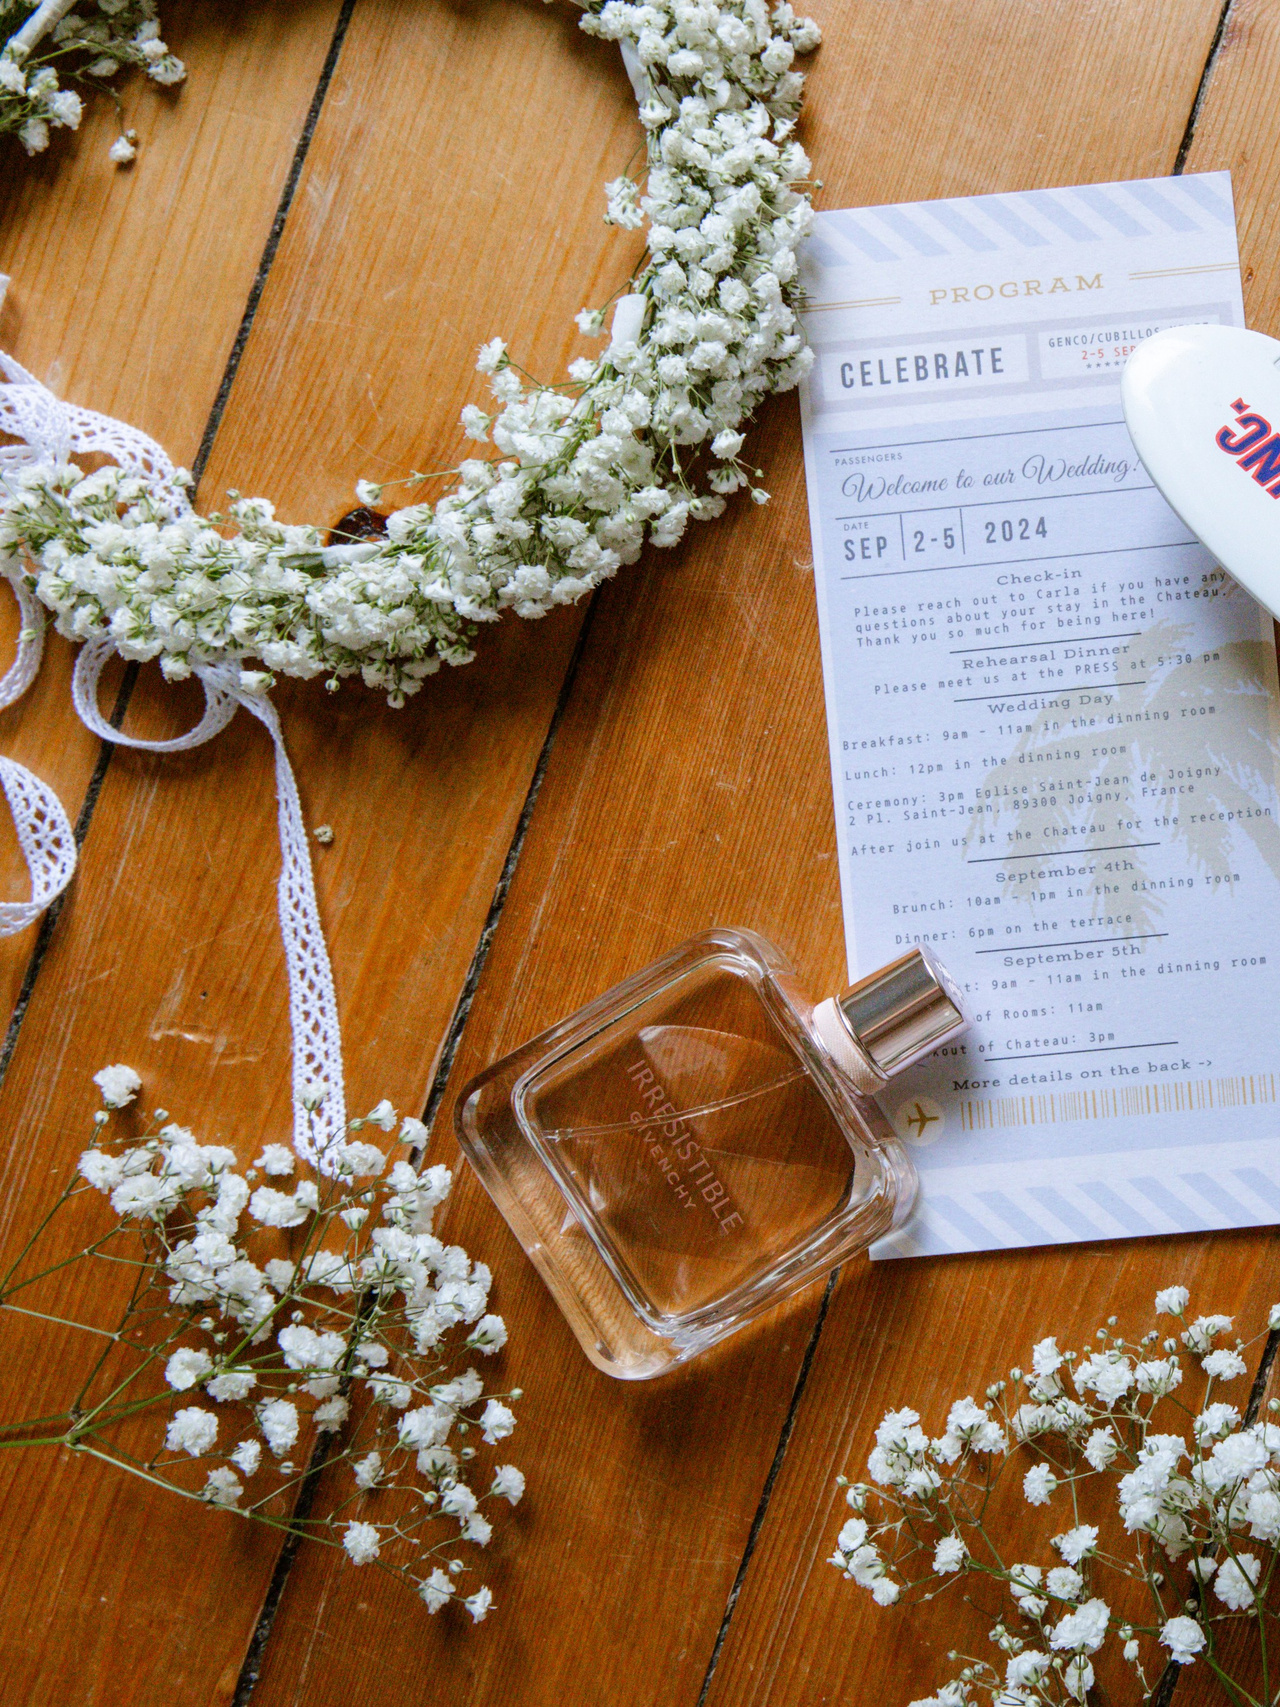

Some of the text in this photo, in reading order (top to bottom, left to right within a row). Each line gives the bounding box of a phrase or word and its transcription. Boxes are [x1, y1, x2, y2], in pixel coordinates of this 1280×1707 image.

[929, 274, 1103, 305] PROGRAM
[840, 347, 1004, 388] CELEBRATE
[1082, 348, 1104, 360] 2-5
[835, 452, 902, 465] PASSENGERS
[841, 454, 1140, 502] Welcome to our Wedding!
[843, 521, 868, 531] DATE
[843, 516, 1047, 561] SEP 2-5 2024
[854, 571, 1226, 617] Please reach out to Carla if you have any
[996, 568, 1081, 585] Check-in
[855, 589, 1226, 634] questions about your stay in the Chateau.
[856, 608, 1153, 647] Thank you so much for being here!
[874, 652, 1220, 694] Please meet us at the PRESS at 5:30 pm
[962, 645, 1129, 669] Rehearsal Dinner
[987, 695, 1112, 714] Wedding Day
[842, 733, 929, 751] Breakfast:
[942, 730, 968, 740] 9am
[998, 724, 1032, 735] 11am
[1044, 720, 1059, 731] in
[1071, 716, 1095, 727] the
[1107, 710, 1169, 723] dinning
[1181, 706, 1215, 717] room
[845, 745, 1126, 780] Lunch: 12pm in the dinning room
[847, 767, 1220, 811] Ceremony: 3pm Eglise Saint-Jean de Joigny
[849, 784, 1194, 826] 2 Pl. Saint-Jean, 89300 Joigny, France
[851, 807, 1271, 856] After join us at the Chateau for the reception
[996, 860, 1134, 884] September 4th
[892, 899, 952, 914] Brunch:
[967, 896, 1000, 907] 10am
[1031, 891, 1055, 902] 1pm
[1067, 887, 1082, 897] in
[1095, 883, 1119, 894] the
[1131, 877, 1193, 891] dinning
[1205, 873, 1240, 884] room
[895, 914, 1131, 944] Dinner: 6pm on the terrace
[991, 979, 1017, 989] 9am
[1048, 974, 1081, 984] 11am
[1093, 969, 1108, 980] in
[1121, 966, 1145, 977] the
[1157, 960, 1219, 974] dinning
[1231, 956, 1266, 967] room
[1003, 944, 1141, 968] September 5th
[976, 1002, 1102, 1022] of Rooms: 11am
[978, 1040, 993, 1052] of
[1006, 1035, 1075, 1050] Chateau:
[1089, 1032, 1114, 1043] 3pm
[952, 1079, 1000, 1091] More
[1008, 1070, 1072, 1085] details
[1080, 1069, 1102, 1078] on
[1110, 1064, 1139, 1076] the
[1148, 1058, 1190, 1072] back
[627, 1060, 744, 1235] IRRESISTIBLE
[630, 1111, 696, 1209] GIVENCHY
